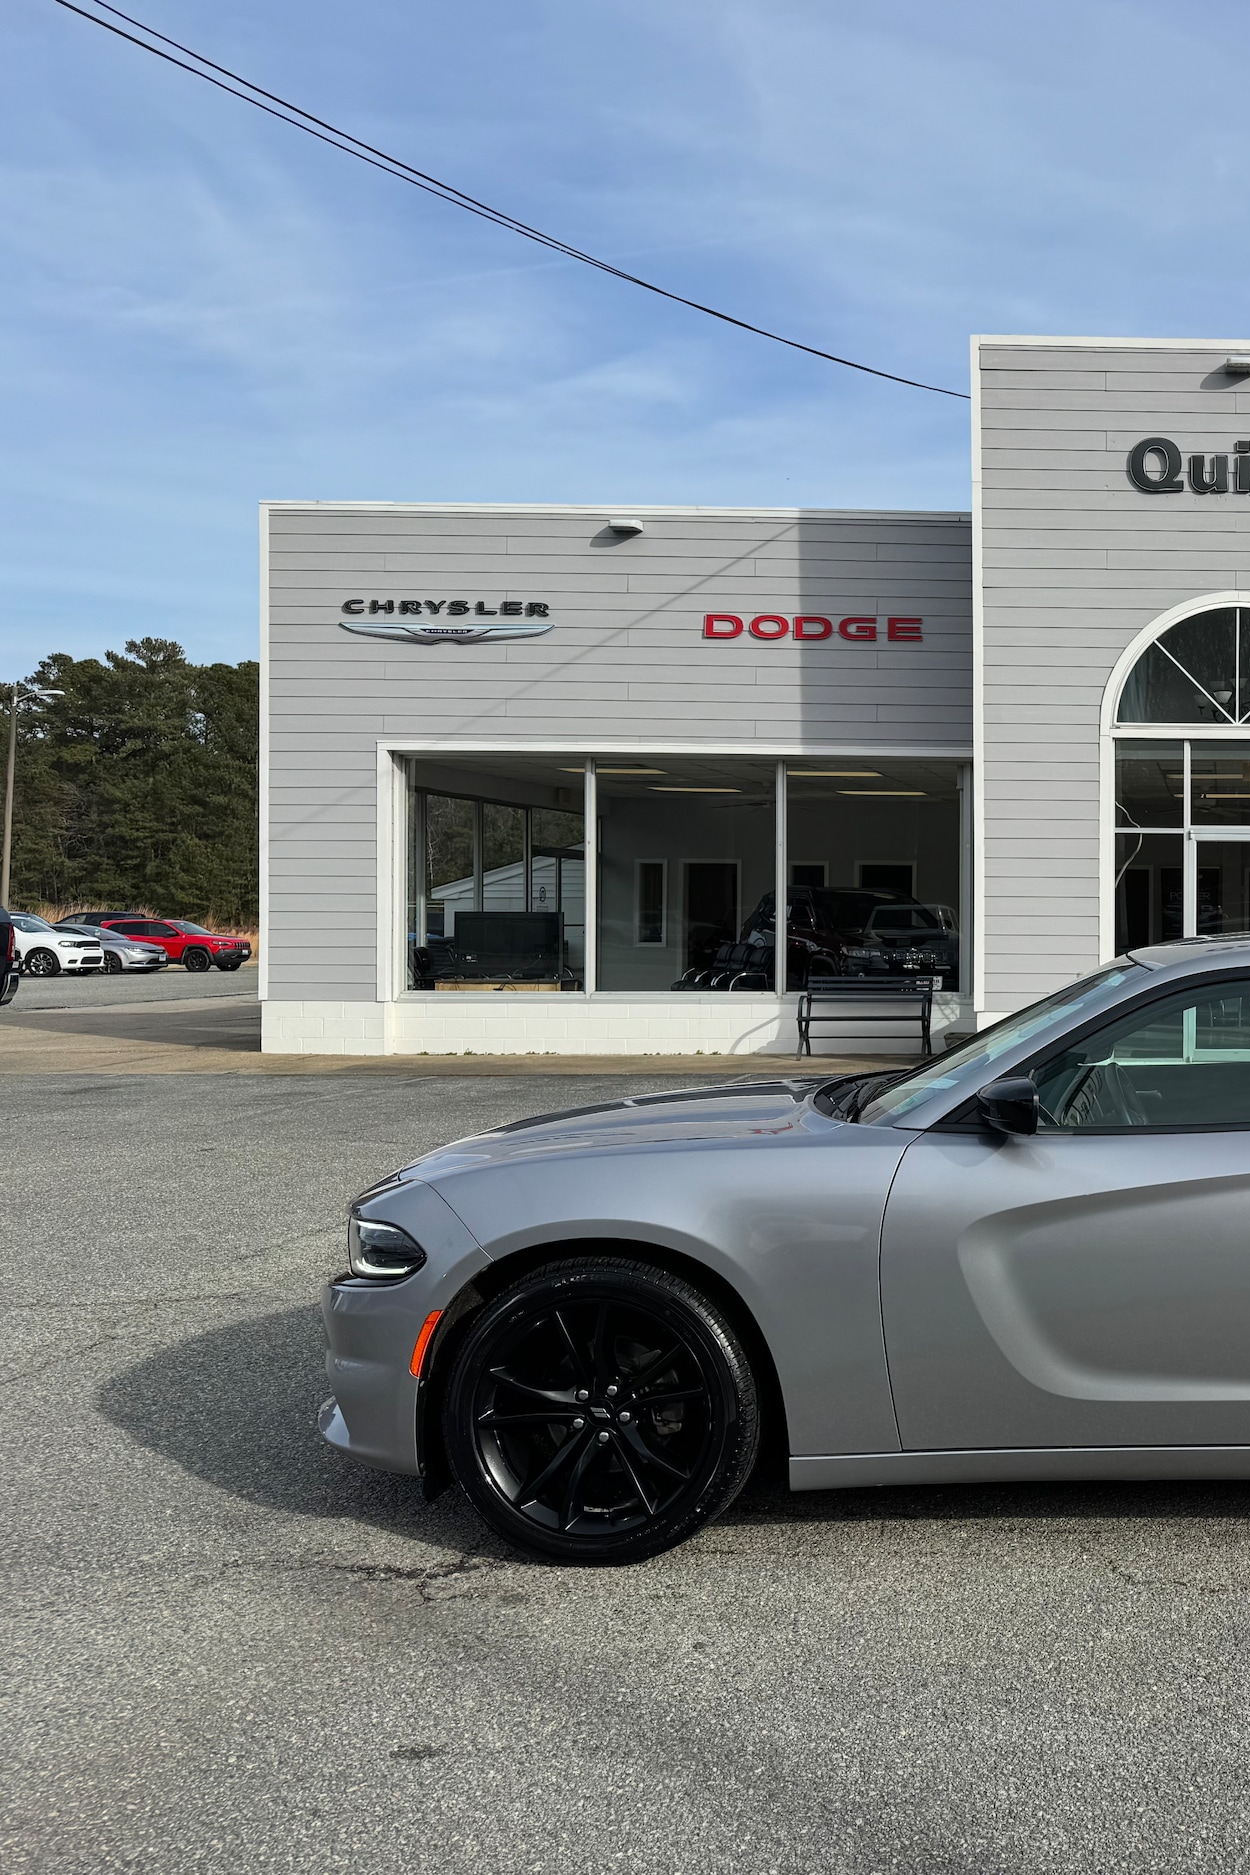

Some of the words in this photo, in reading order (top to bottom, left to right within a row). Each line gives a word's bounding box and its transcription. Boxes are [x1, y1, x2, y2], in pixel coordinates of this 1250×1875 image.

[342, 599, 550, 617] CHRYSLER
[703, 613, 923, 641] DODGE
[1169, 891, 1211, 900] POER
